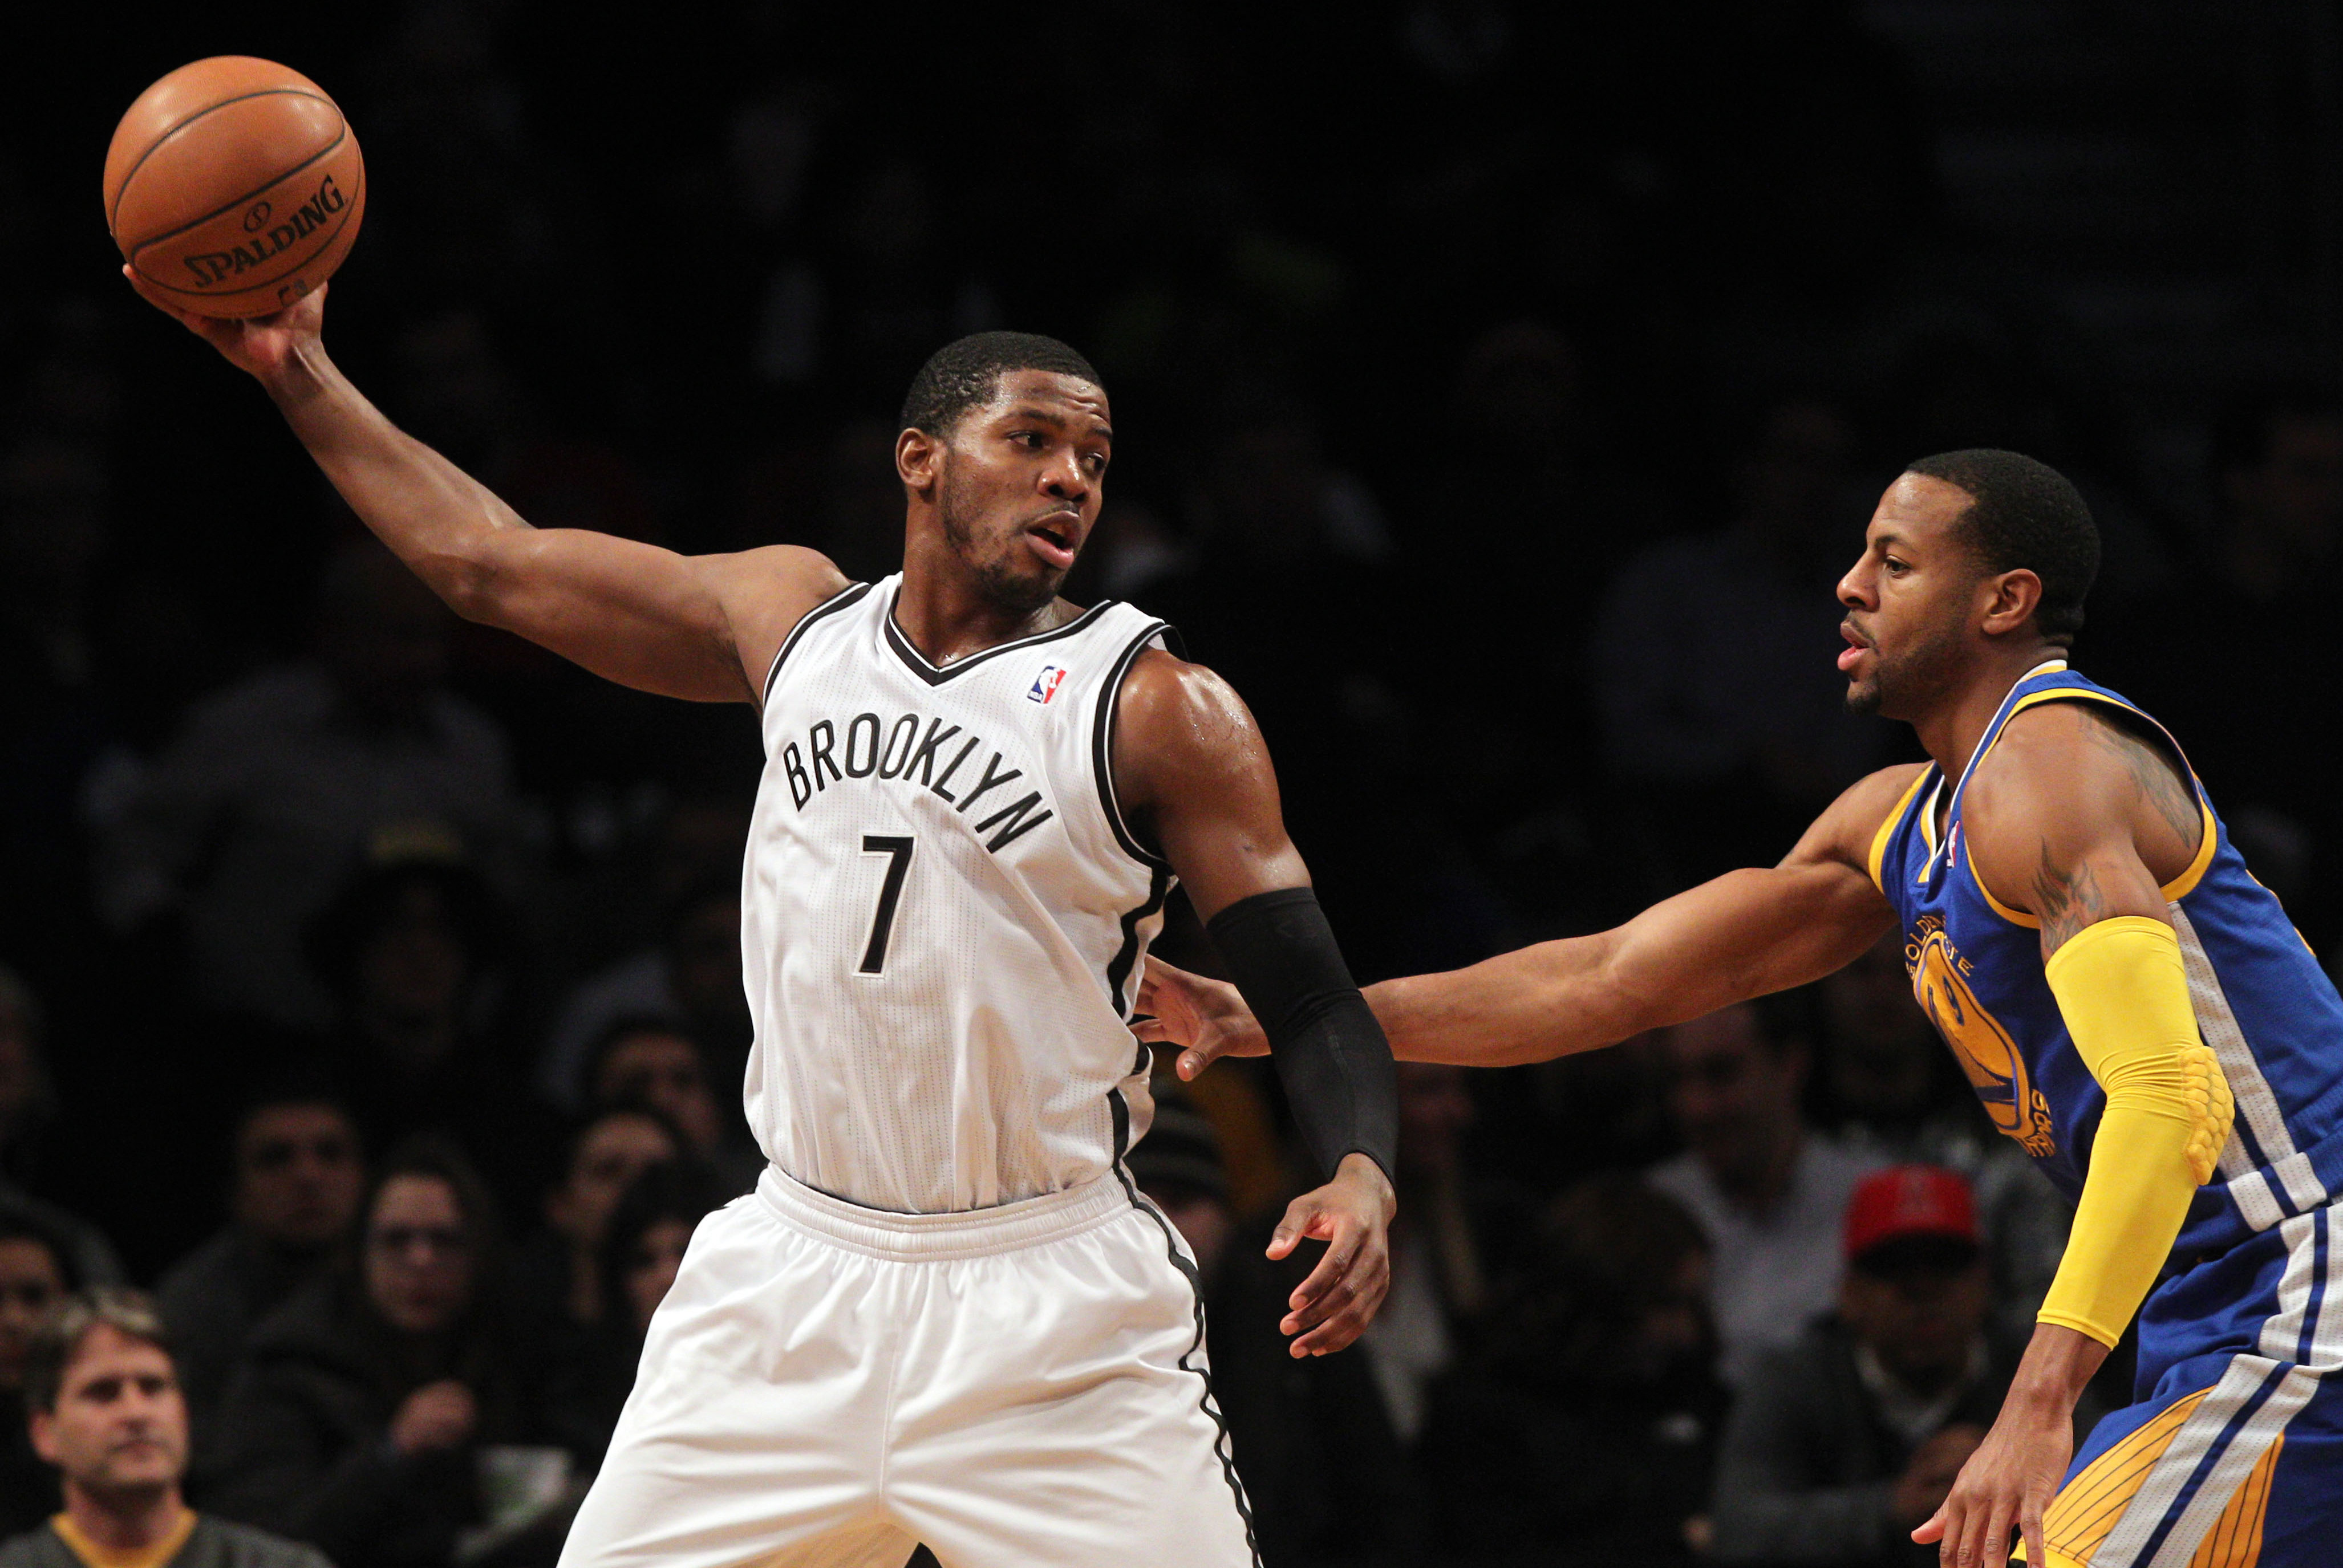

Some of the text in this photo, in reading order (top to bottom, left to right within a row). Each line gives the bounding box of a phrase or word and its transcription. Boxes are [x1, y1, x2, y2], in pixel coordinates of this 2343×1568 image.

[184, 174, 344, 288] SPALDING
[784, 713, 1053, 854] BROOKLYN
[857, 835, 915, 975] 7
